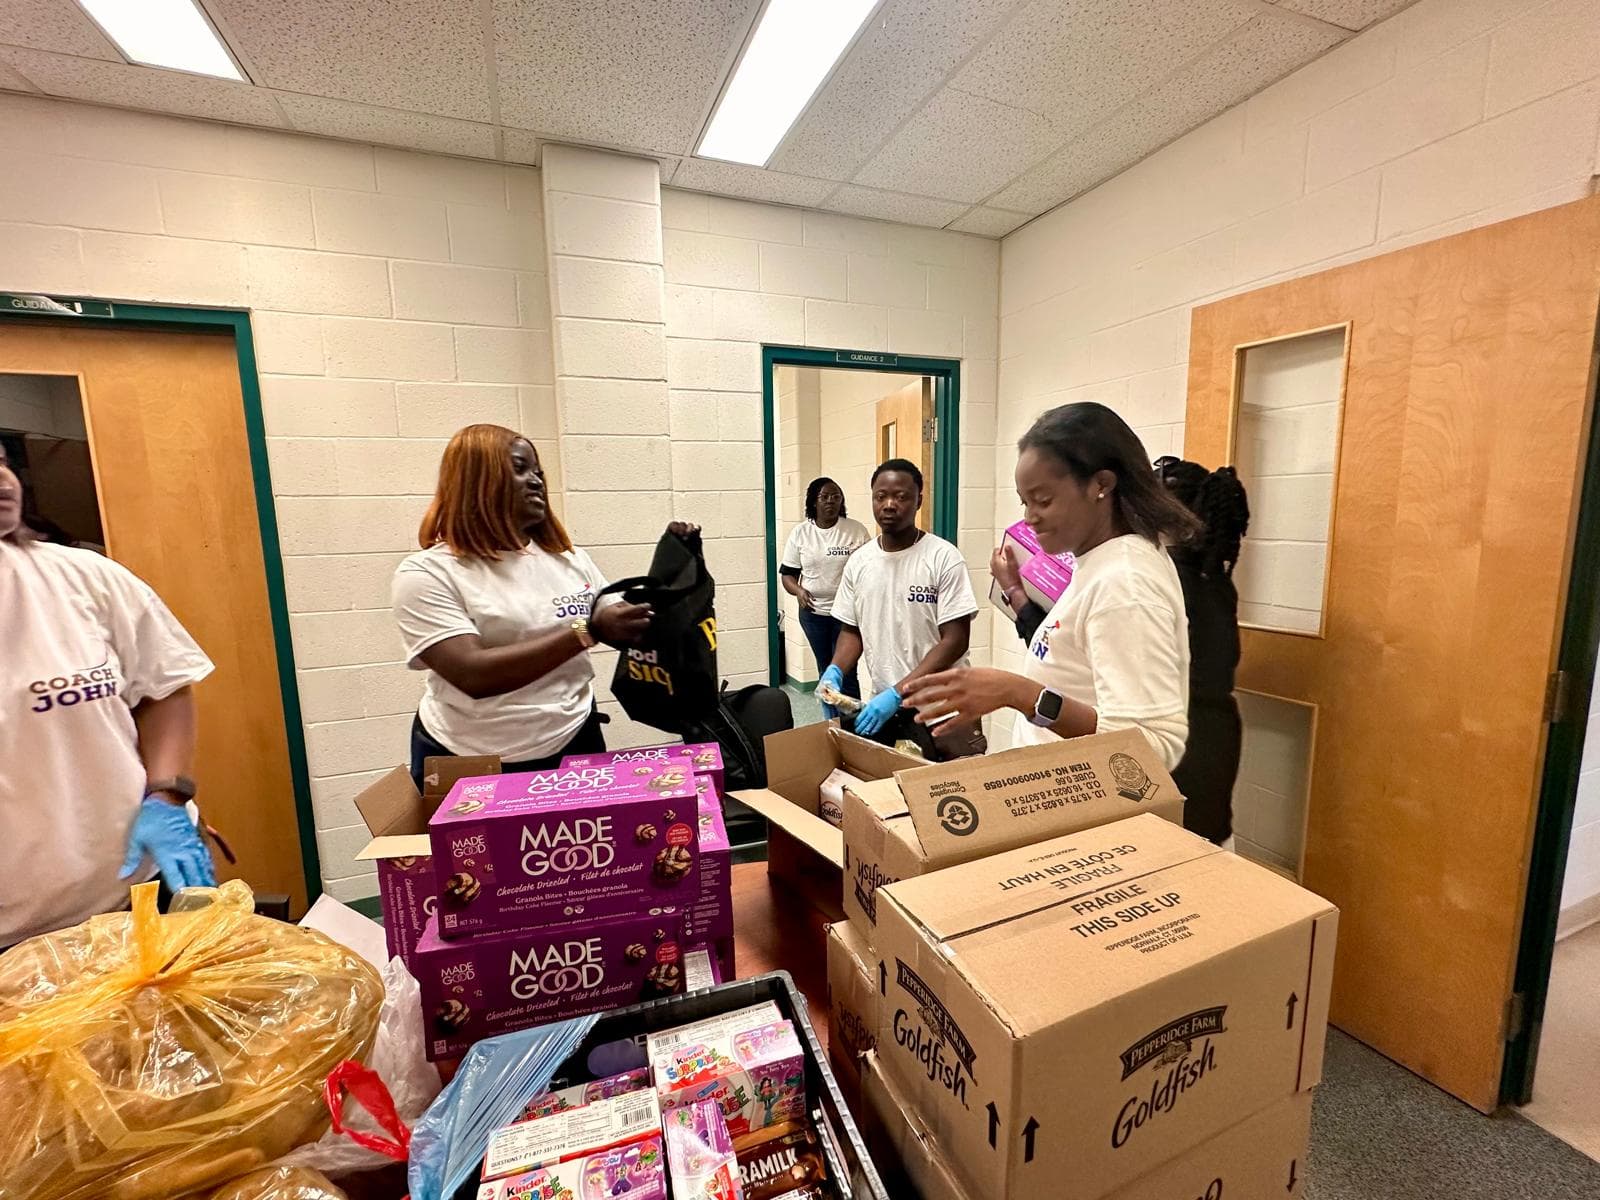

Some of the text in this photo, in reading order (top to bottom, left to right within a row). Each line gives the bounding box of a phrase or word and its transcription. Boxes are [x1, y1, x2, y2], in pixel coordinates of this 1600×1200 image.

[850, 353, 878, 362] GUIDANCE
[908, 593, 938, 604] JOHN
[909, 585, 939, 595] COACH
[552, 593, 590, 607] COACH
[29, 668, 116, 694] COACH
[31, 681, 117, 713] JOHN
[612, 748, 669, 761] MADE
[530, 766, 616, 785] MADE
[1052, 766, 1068, 777] NO.
[1068, 761, 1092, 774] ITEM
[527, 776, 614, 795] GOOD
[1055, 770, 1096, 786] CUBE 0.66
[1087, 779, 1101, 790] O.D.
[929, 785, 966, 799] Corrugated
[1018, 790, 1046, 803] 8.9375
[1052, 783, 1083, 797] 16.0625
[1069, 792, 1092, 804] 15.75
[1004, 797, 1011, 808] 8
[452, 834, 486, 850] MADE
[520, 816, 614, 852] MADE
[453, 844, 487, 858] GOOD
[1112, 844, 1138, 856] CE
[521, 842, 616, 877] GOOD
[1043, 863, 1073, 877] EN
[1050, 863, 1123, 890] FRAGILE
[496, 862, 644, 897] Chocolate Drizzled Filet de chocolat
[998, 871, 1047, 891] HAUT
[515, 883, 629, 904] Granola Bites Bouchées granola
[1070, 884, 1147, 916] FRAGILE
[1070, 892, 1181, 939] THIS SIDE UP
[509, 938, 603, 976] MADE
[441, 962, 475, 978] MADE
[442, 970, 476, 985] GOOD
[510, 963, 604, 999] GOOD
[485, 981, 634, 1021] Chocolate Drizzled Filet de chocolat
[901, 967, 967, 1059] PEPPERIDGE FARM
[1130, 1015, 1216, 1068] PEPPERIDGE FARM
[665, 1047, 721, 1080] SURPRISE
[676, 1049, 705, 1065] Kinder
[893, 1008, 967, 1106] Goldfish
[1111, 1037, 1215, 1149] Goldfish
[525, 1098, 554, 1113] Kinder
[738, 1147, 798, 1186] RAMILK
[507, 1176, 546, 1197] Kinder
